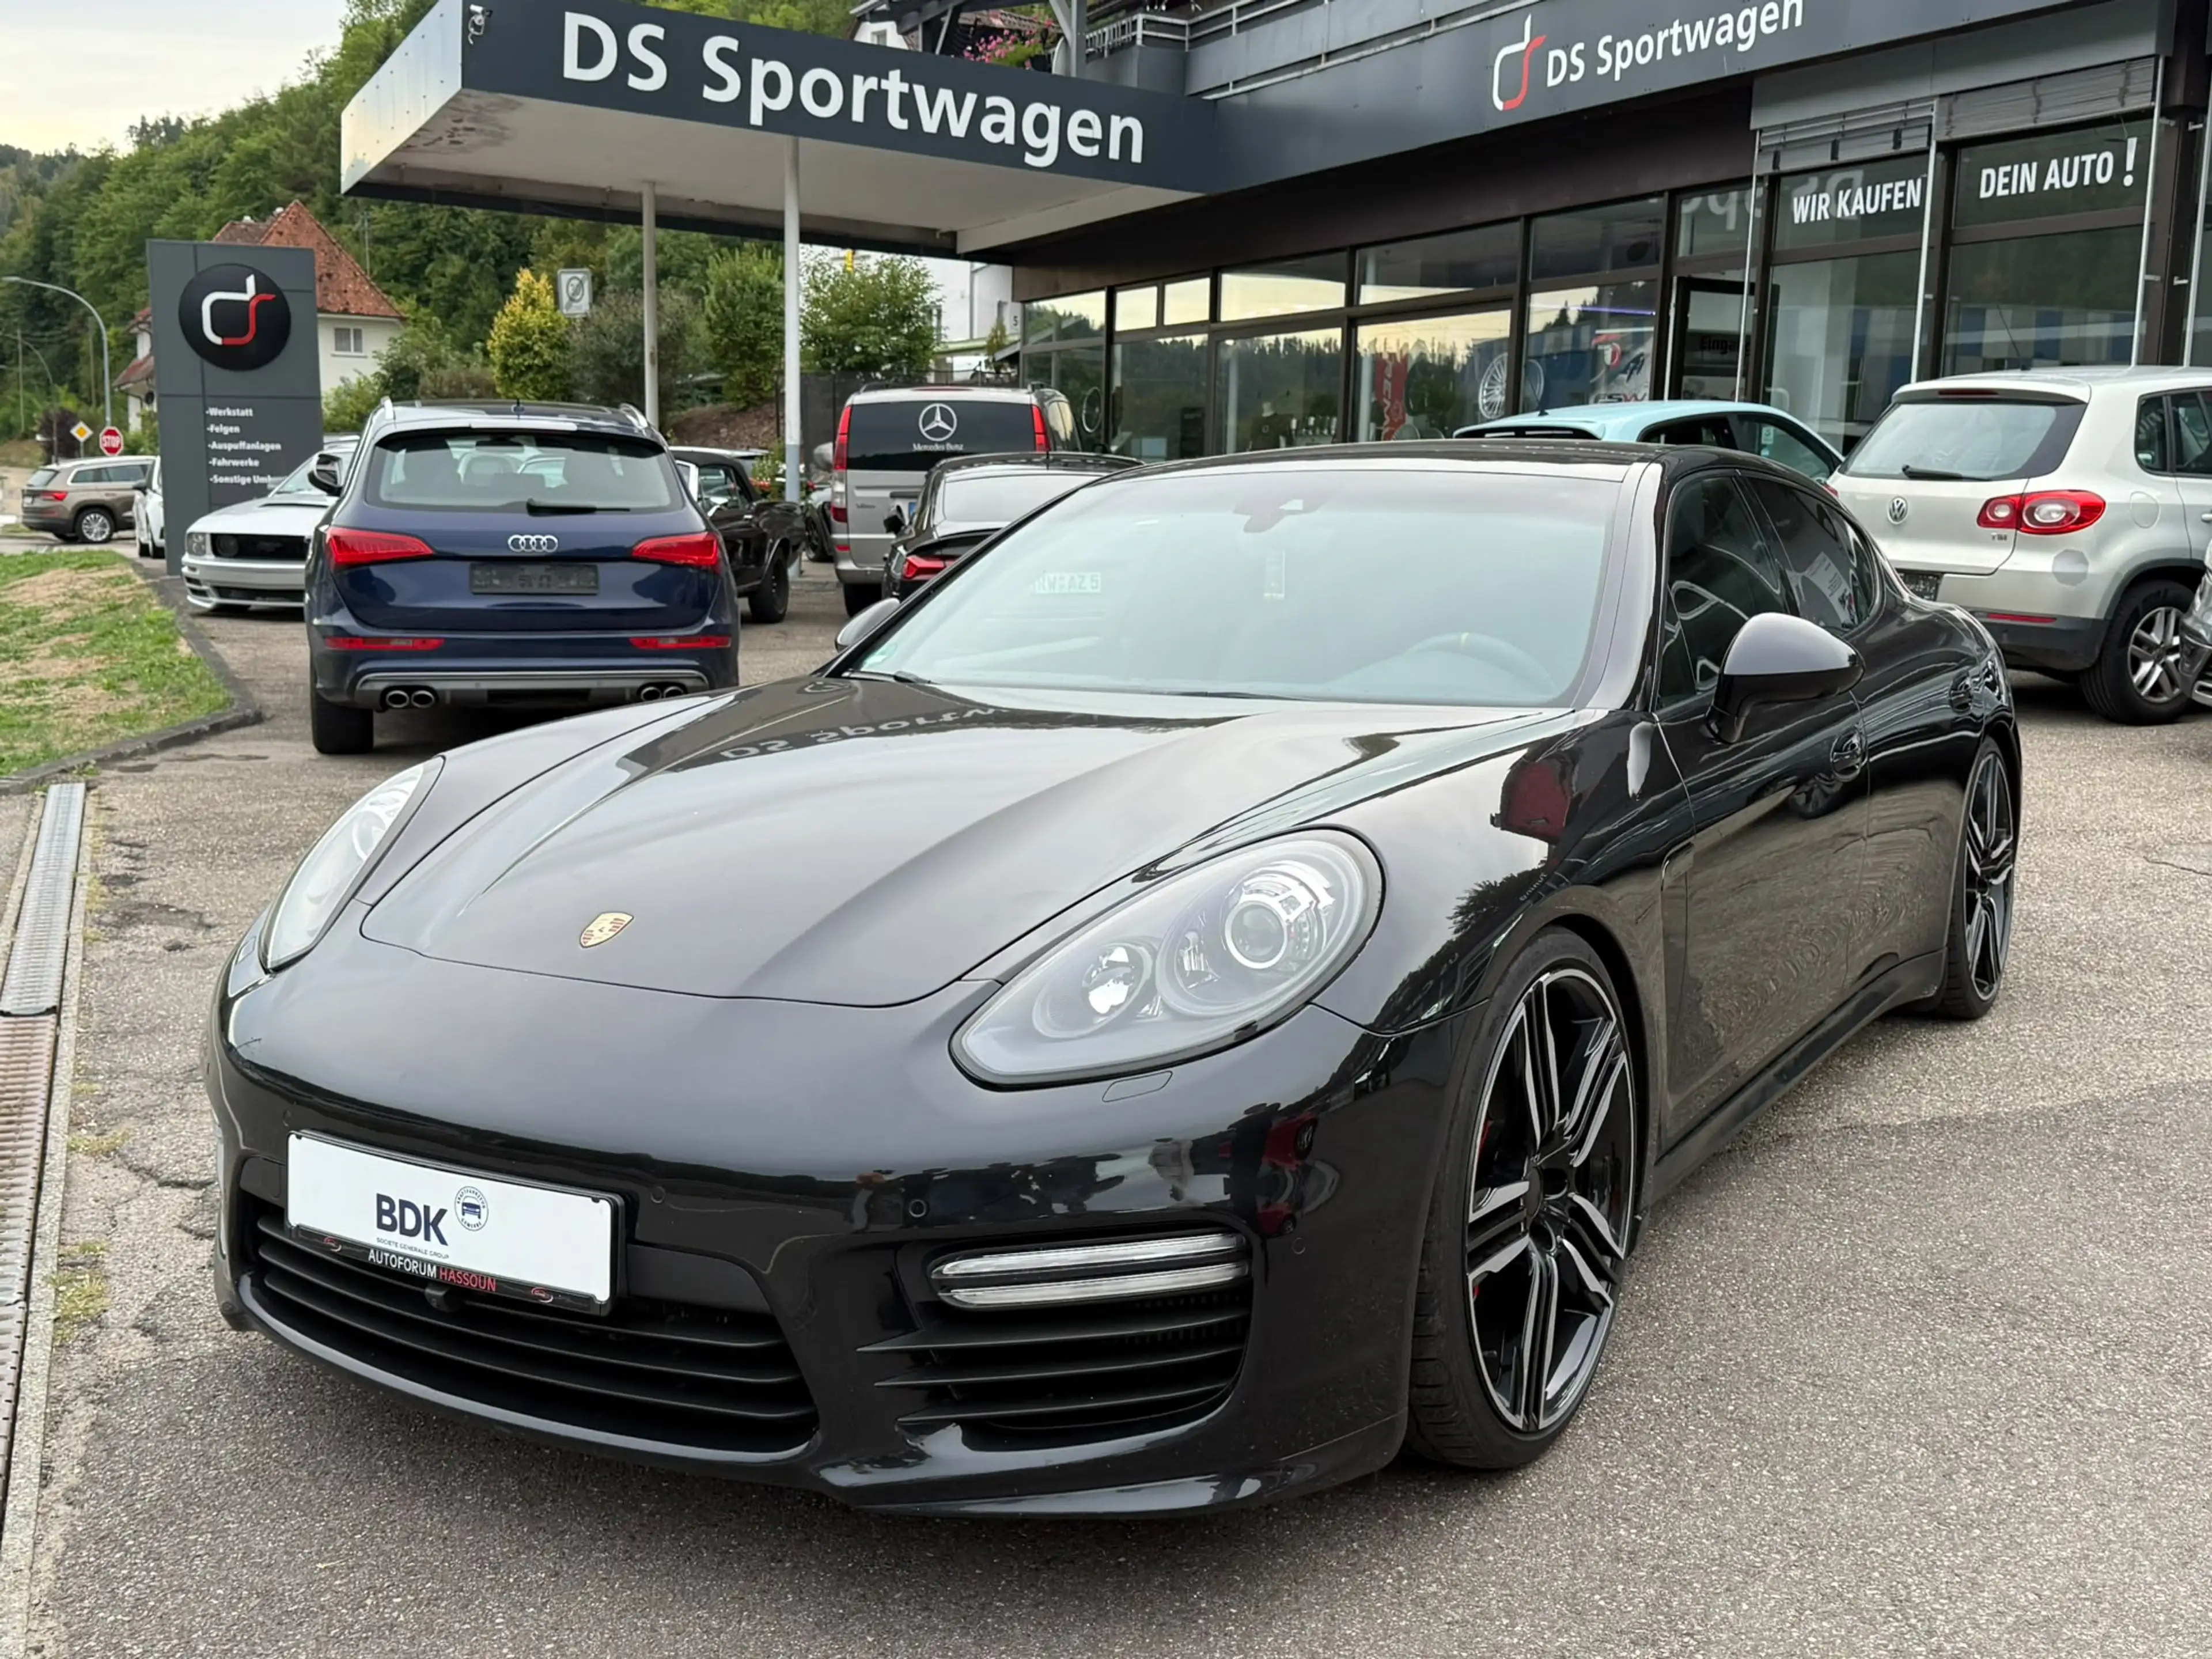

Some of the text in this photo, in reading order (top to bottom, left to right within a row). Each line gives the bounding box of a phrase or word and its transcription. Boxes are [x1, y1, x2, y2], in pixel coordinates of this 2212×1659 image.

[1547, 0, 1804, 88] DS Sportwagen
[563, 12, 1145, 167] DS Sportwagen
[1979, 161, 2038, 199] DEIN
[2043, 150, 2114, 191] AUTO
[1793, 192, 1831, 224] WIR
[1836, 177, 1922, 218] KAUFEN
[102, 434, 121, 448] STOP
[376, 1192, 449, 1246] BDK
[368, 1248, 497, 1293] AUTOFORUM HASSOUN
